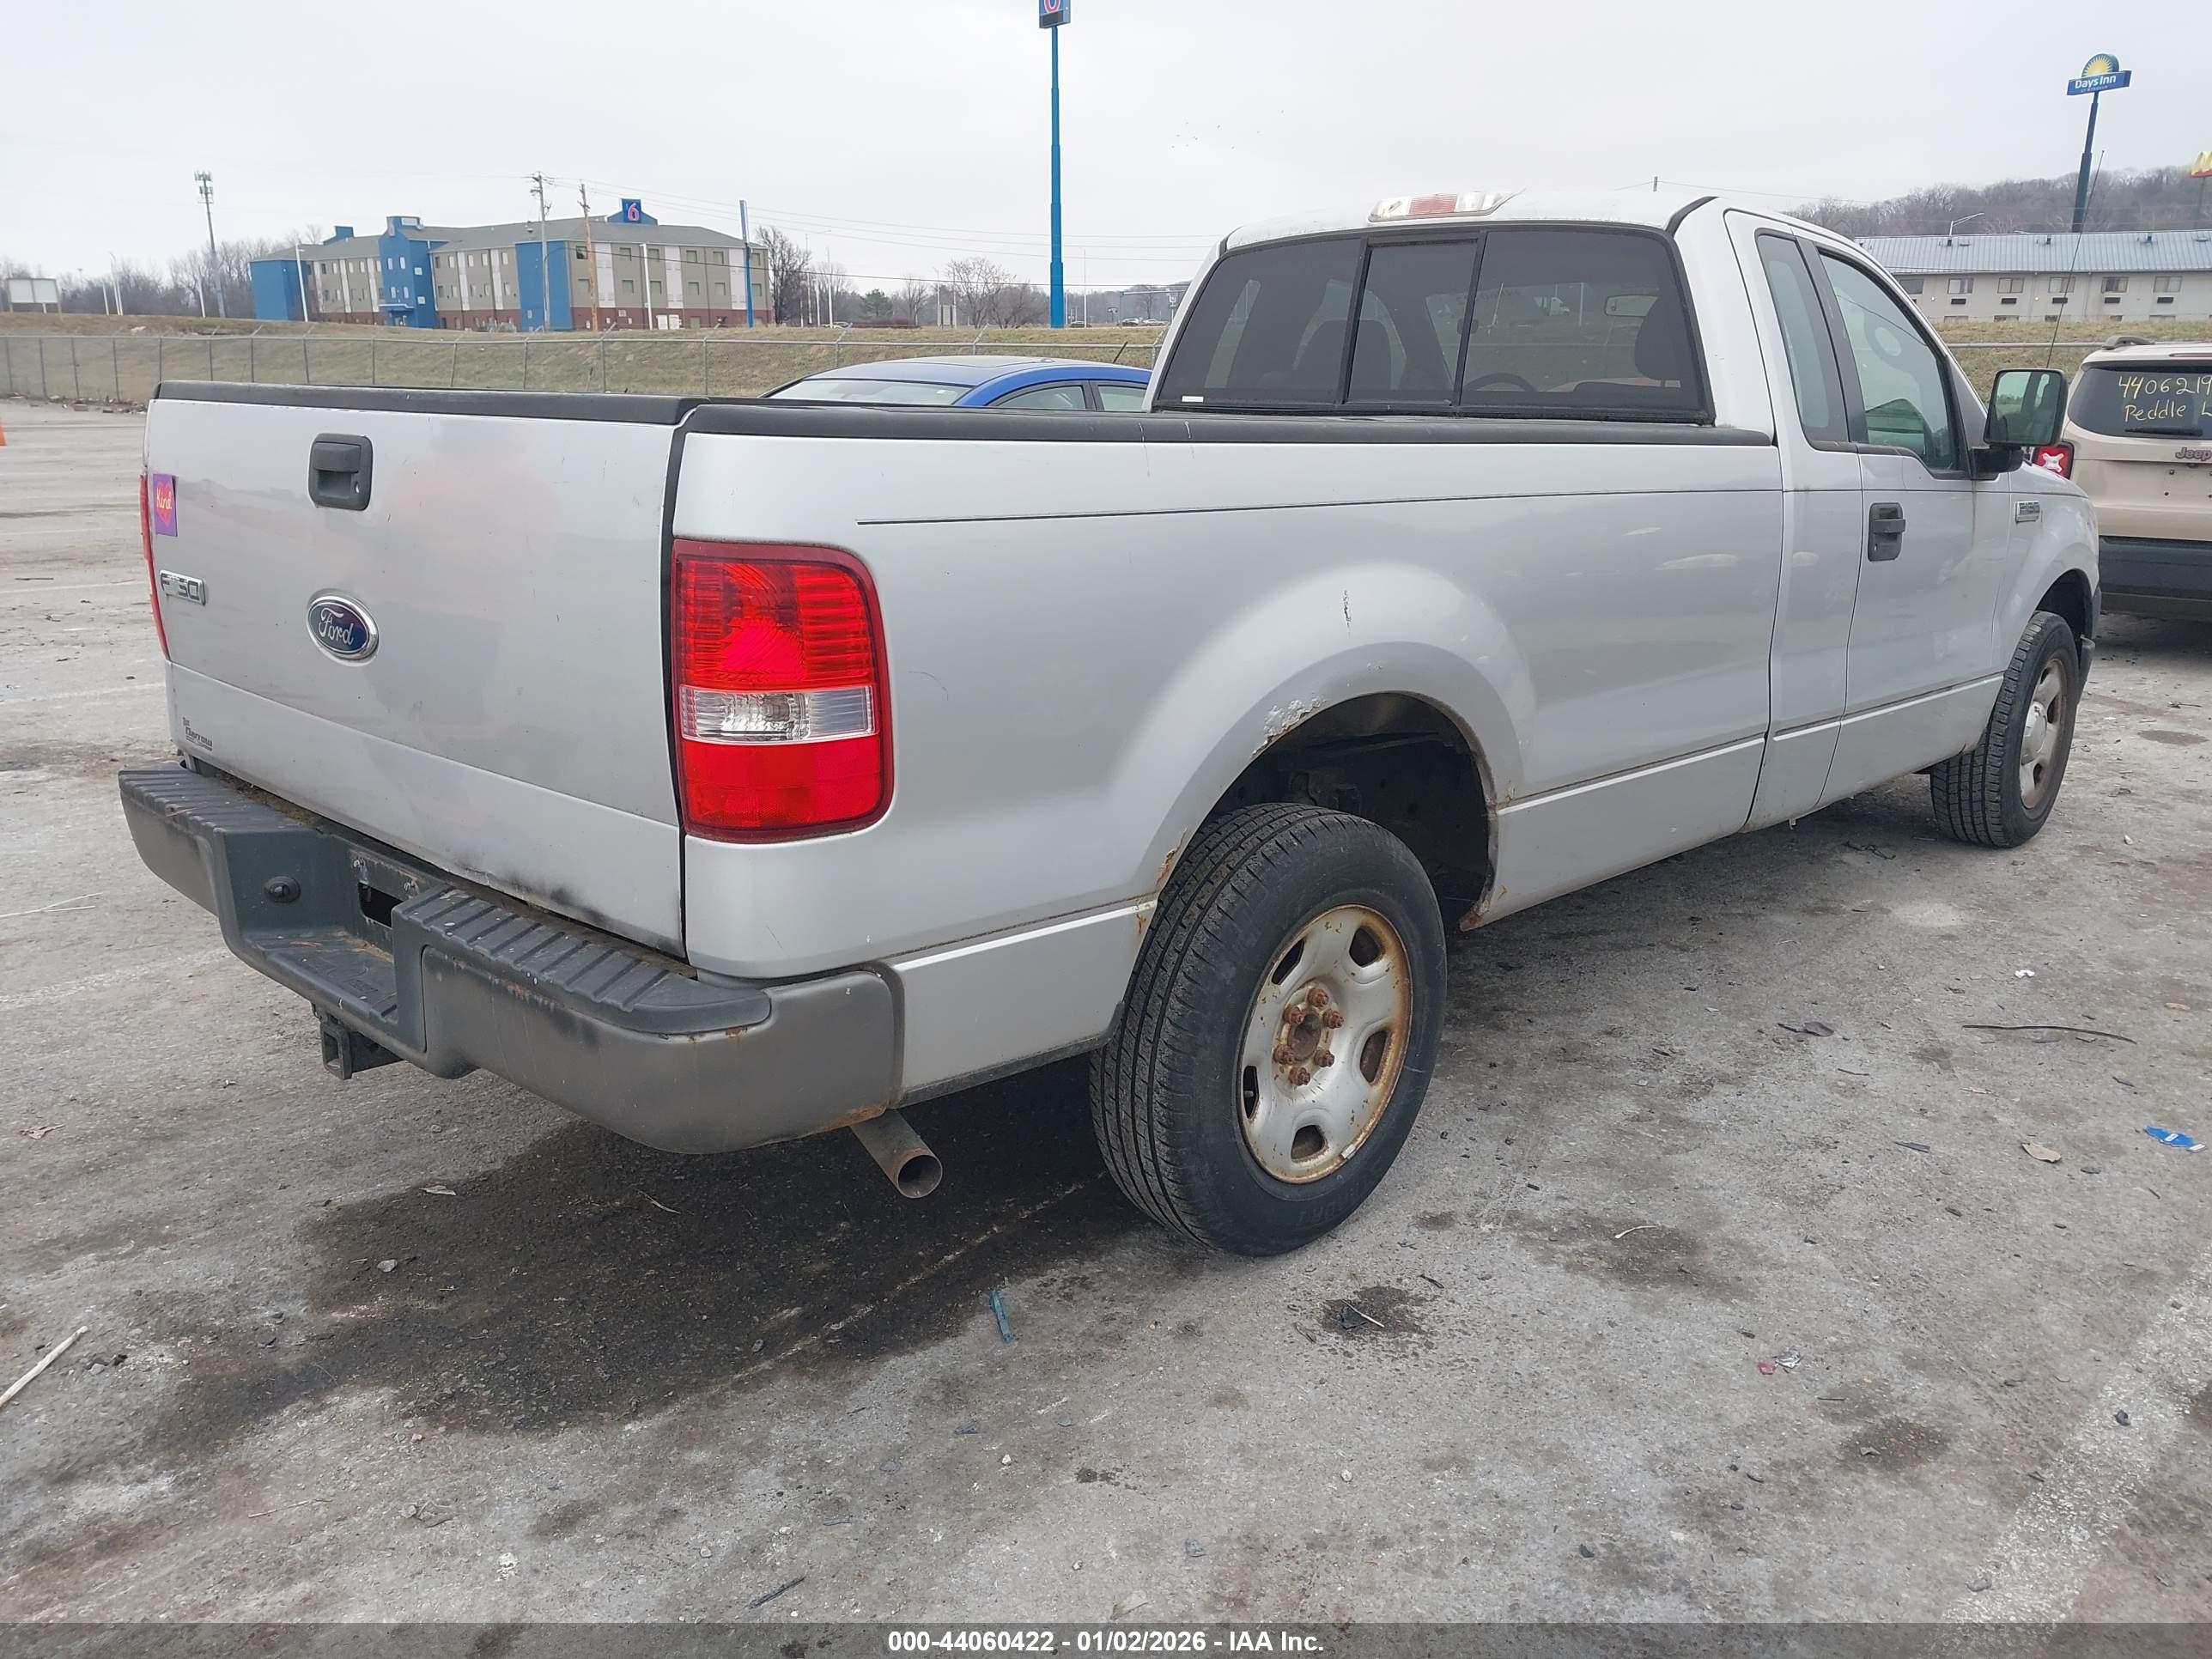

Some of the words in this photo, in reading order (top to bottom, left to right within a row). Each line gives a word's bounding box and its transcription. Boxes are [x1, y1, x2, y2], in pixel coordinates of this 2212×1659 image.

[2075, 77, 2100, 89] Days
[2100, 75, 2117, 85] Inn
[628, 203, 640, 221] 6
[2124, 399, 2186, 422] Peddle
[2174, 447, 2212, 462] Jeep
[156, 487, 173, 510] Kind
[318, 607, 355, 646] Ford
